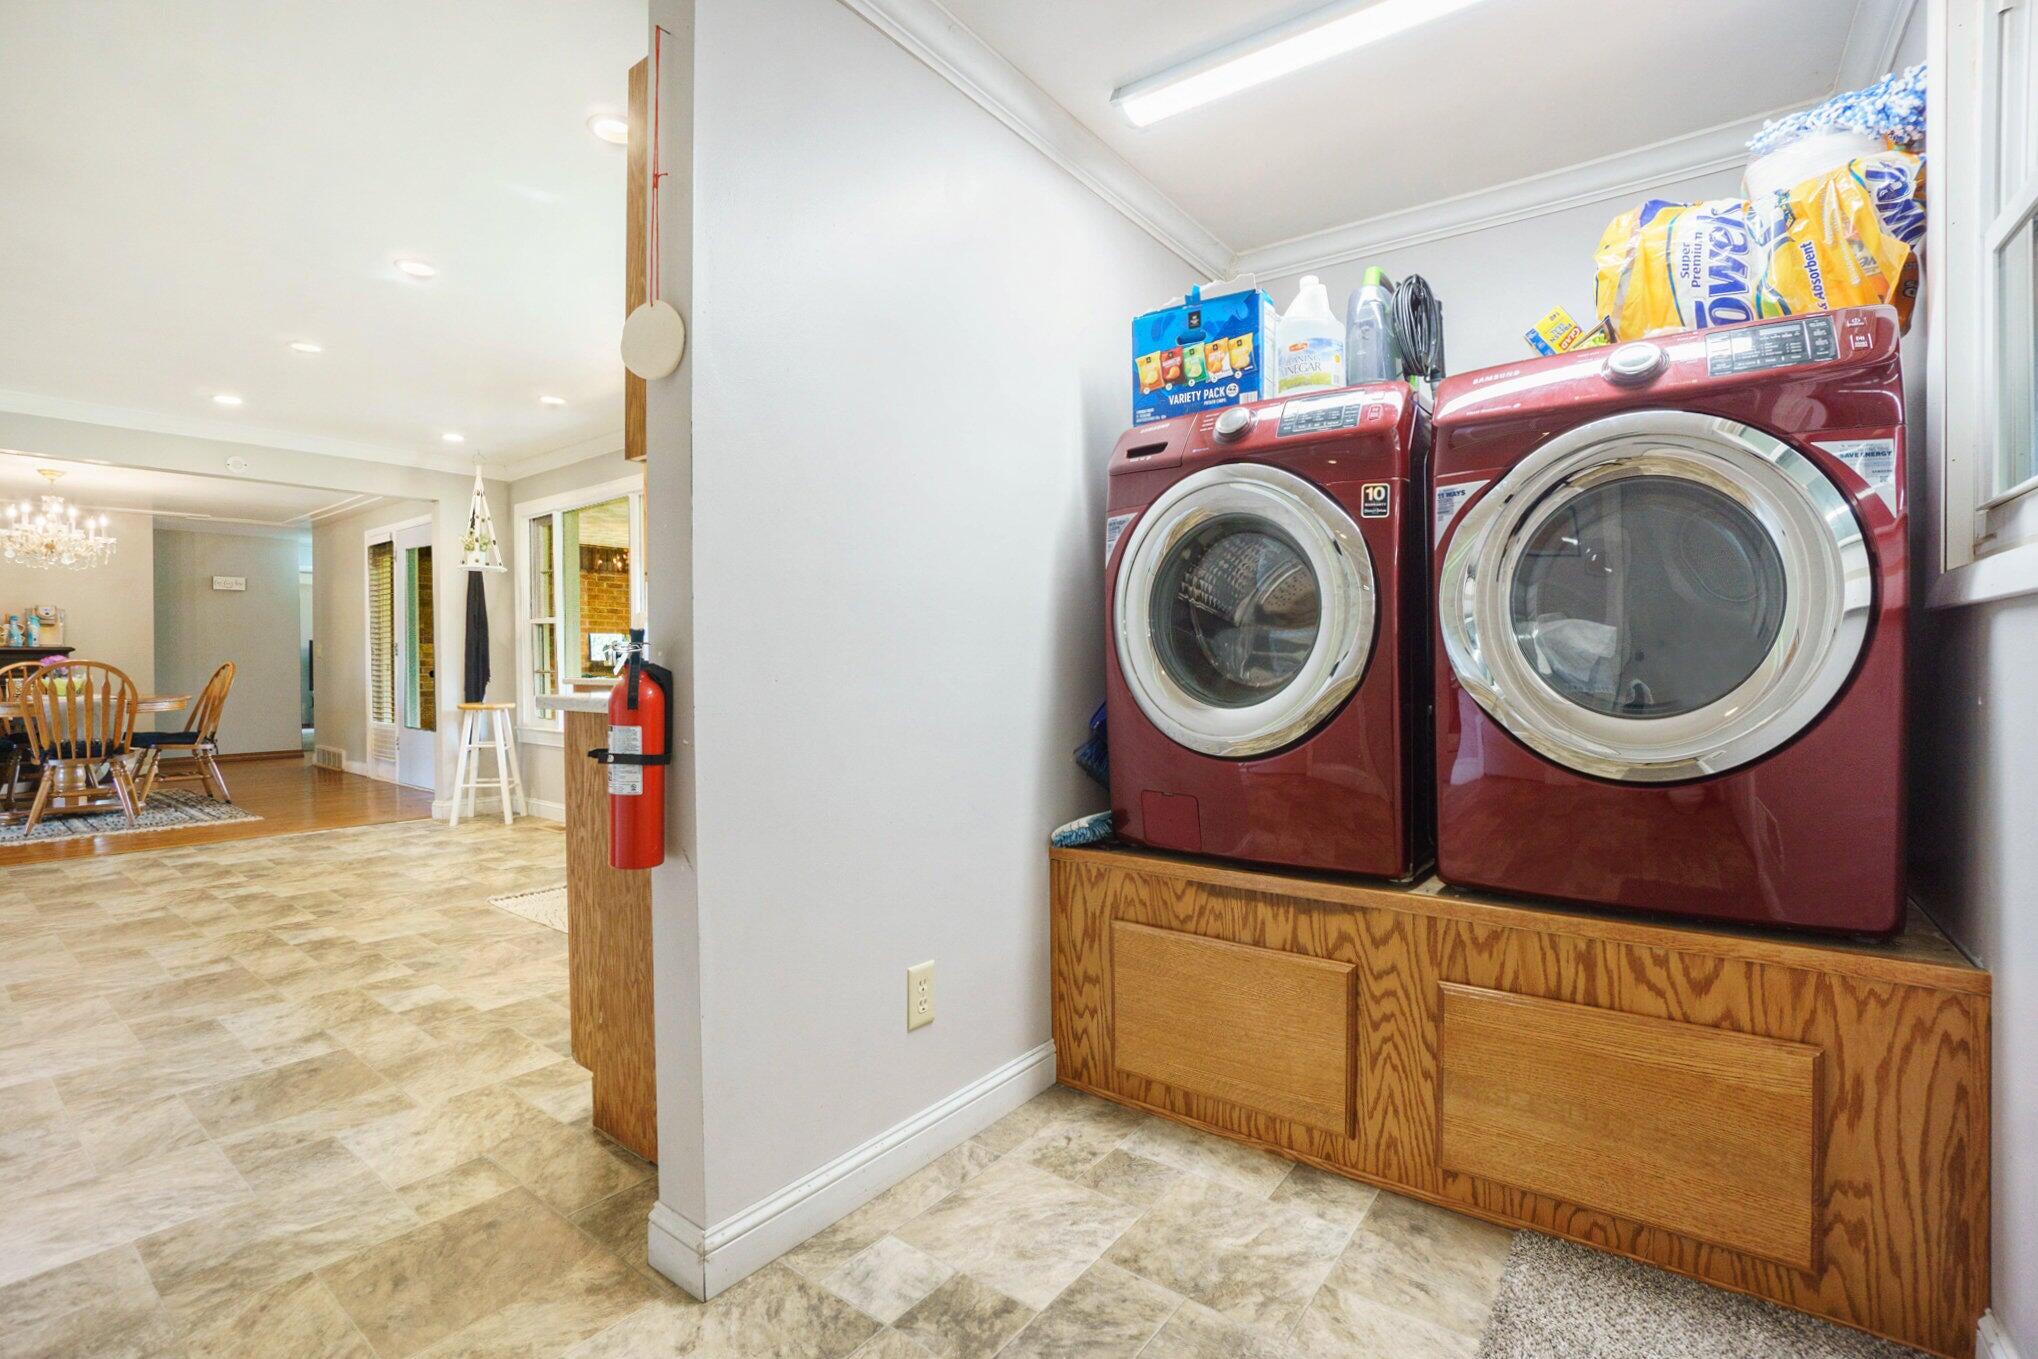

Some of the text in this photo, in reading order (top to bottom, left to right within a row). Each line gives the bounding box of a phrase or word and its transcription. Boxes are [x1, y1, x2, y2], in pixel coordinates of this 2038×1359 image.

[1680, 242, 1691, 279] Super
[1691, 231, 1703, 288] Premium
[1800, 241, 1826, 300] Absorbent
[1472, 369, 1520, 386] SAMSUNG
[1168, 387, 1226, 405] VARIETY PACK
[1365, 486, 1386, 501] 10
